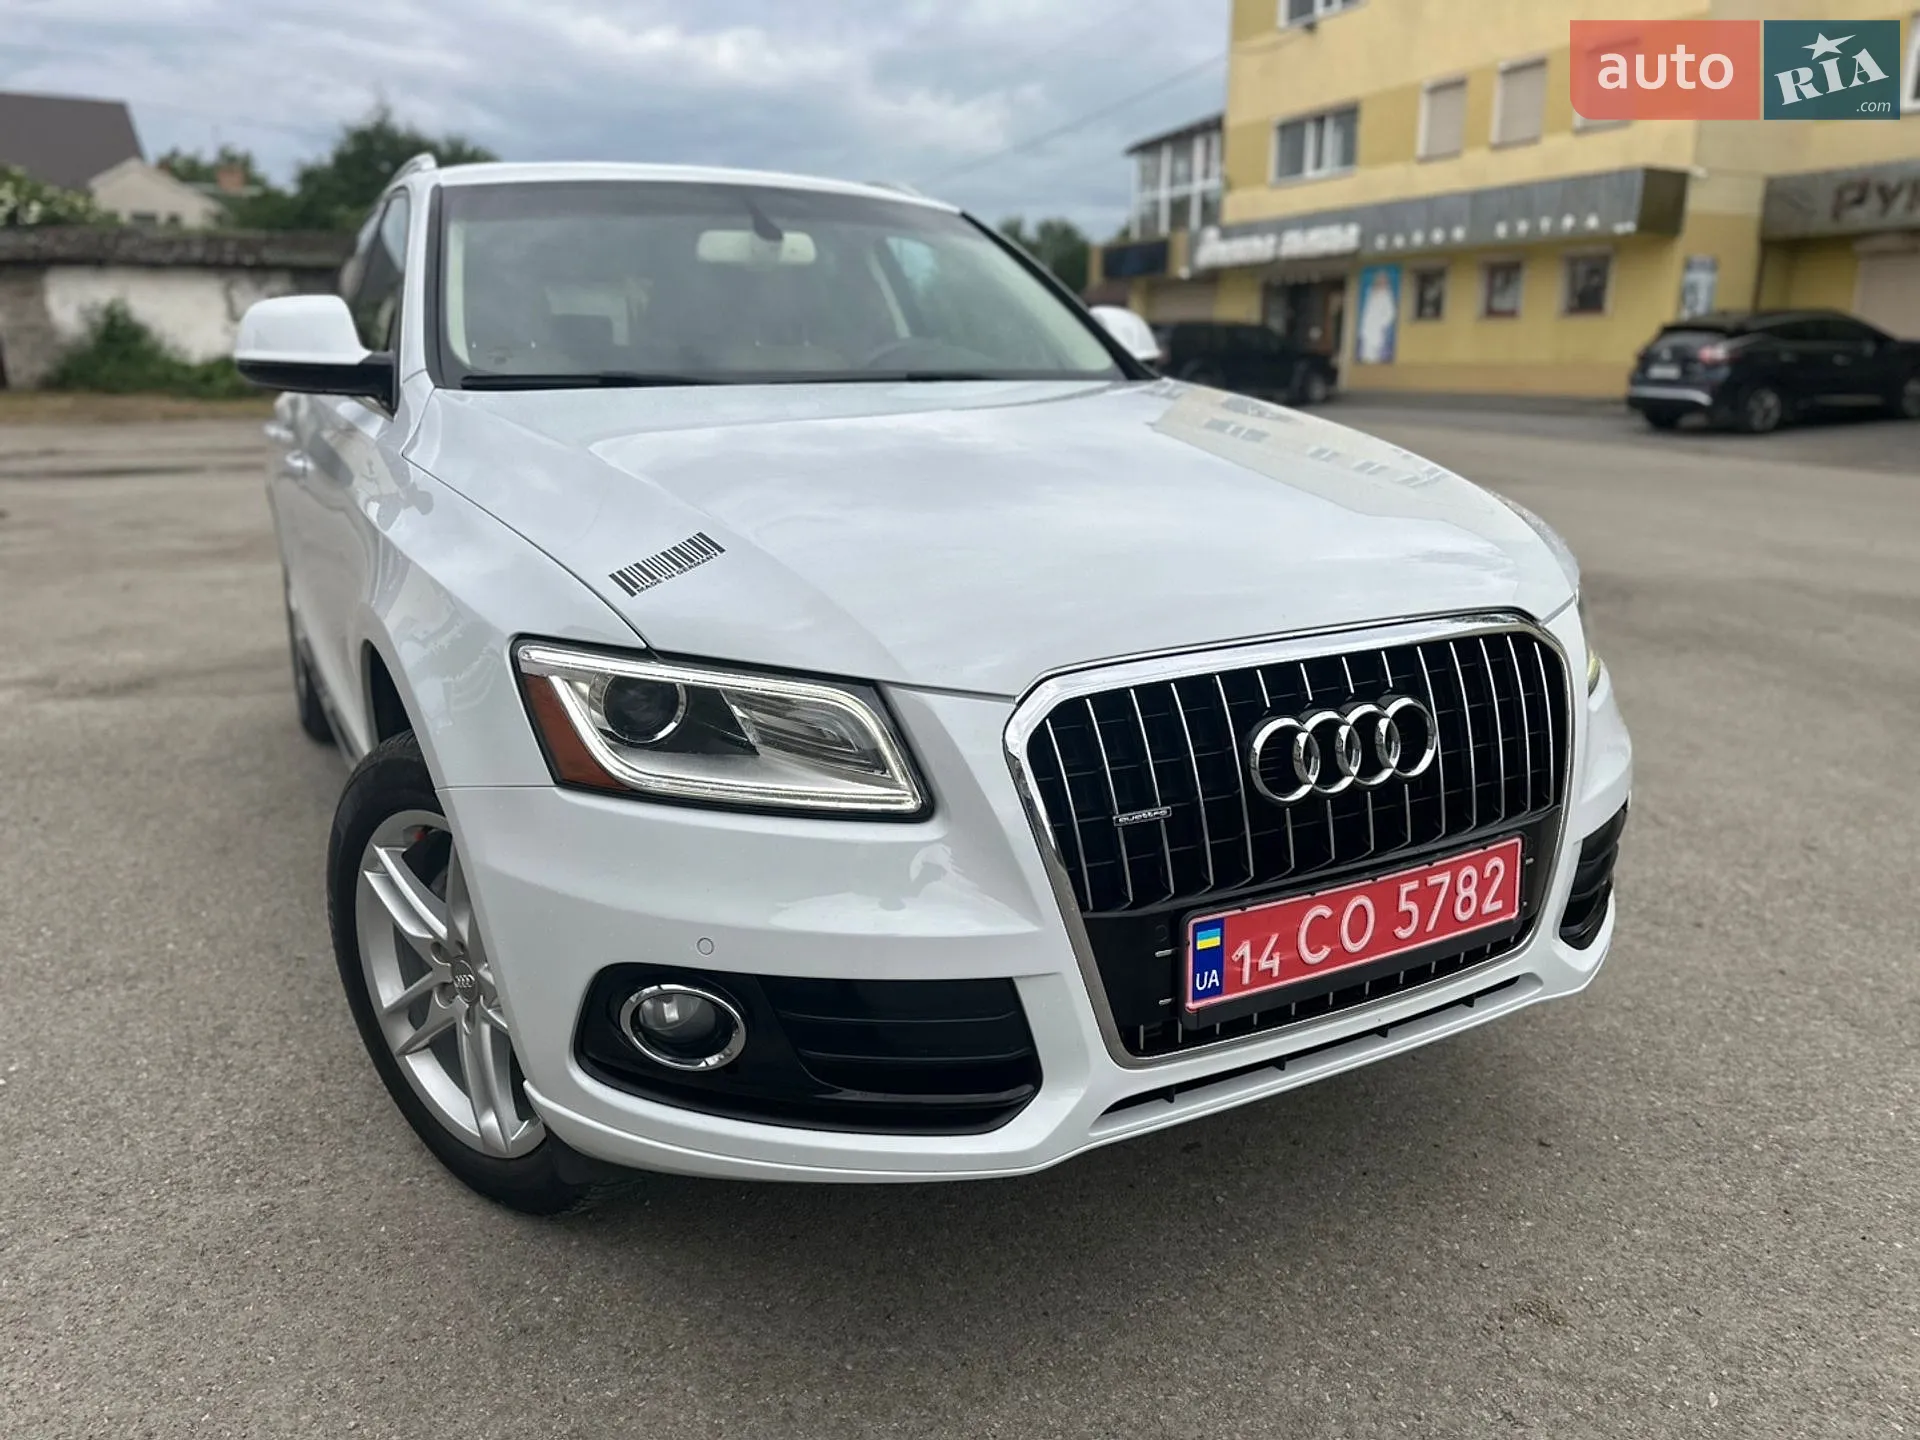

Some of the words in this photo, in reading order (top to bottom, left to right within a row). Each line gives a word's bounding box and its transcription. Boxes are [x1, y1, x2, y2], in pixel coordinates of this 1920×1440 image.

[1118, 809, 1168, 823] quattro
[1231, 933, 1281, 985] 14
[1297, 894, 1377, 965] CO
[1393, 856, 1506, 940] 5782
[1195, 969, 1220, 991] UA
